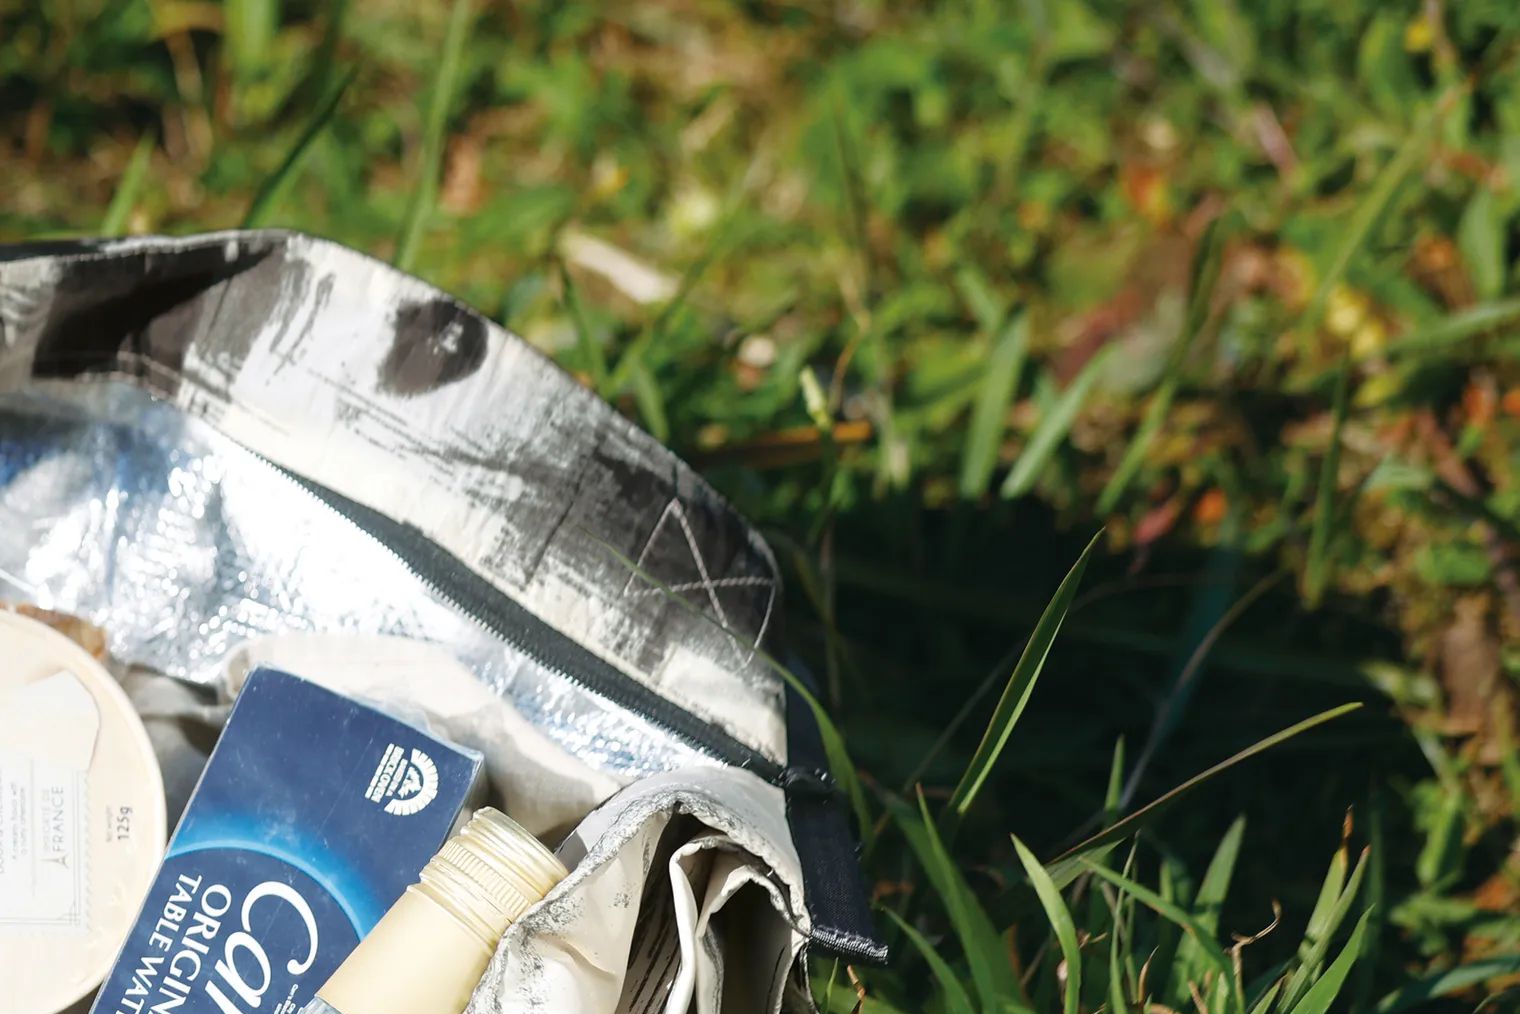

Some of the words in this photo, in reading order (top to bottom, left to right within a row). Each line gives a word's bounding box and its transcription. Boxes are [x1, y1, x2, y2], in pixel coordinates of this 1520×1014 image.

[51, 786, 65, 853] FRANCE
[116, 805, 133, 841] 125g
[148, 874, 202, 952] TABLE
